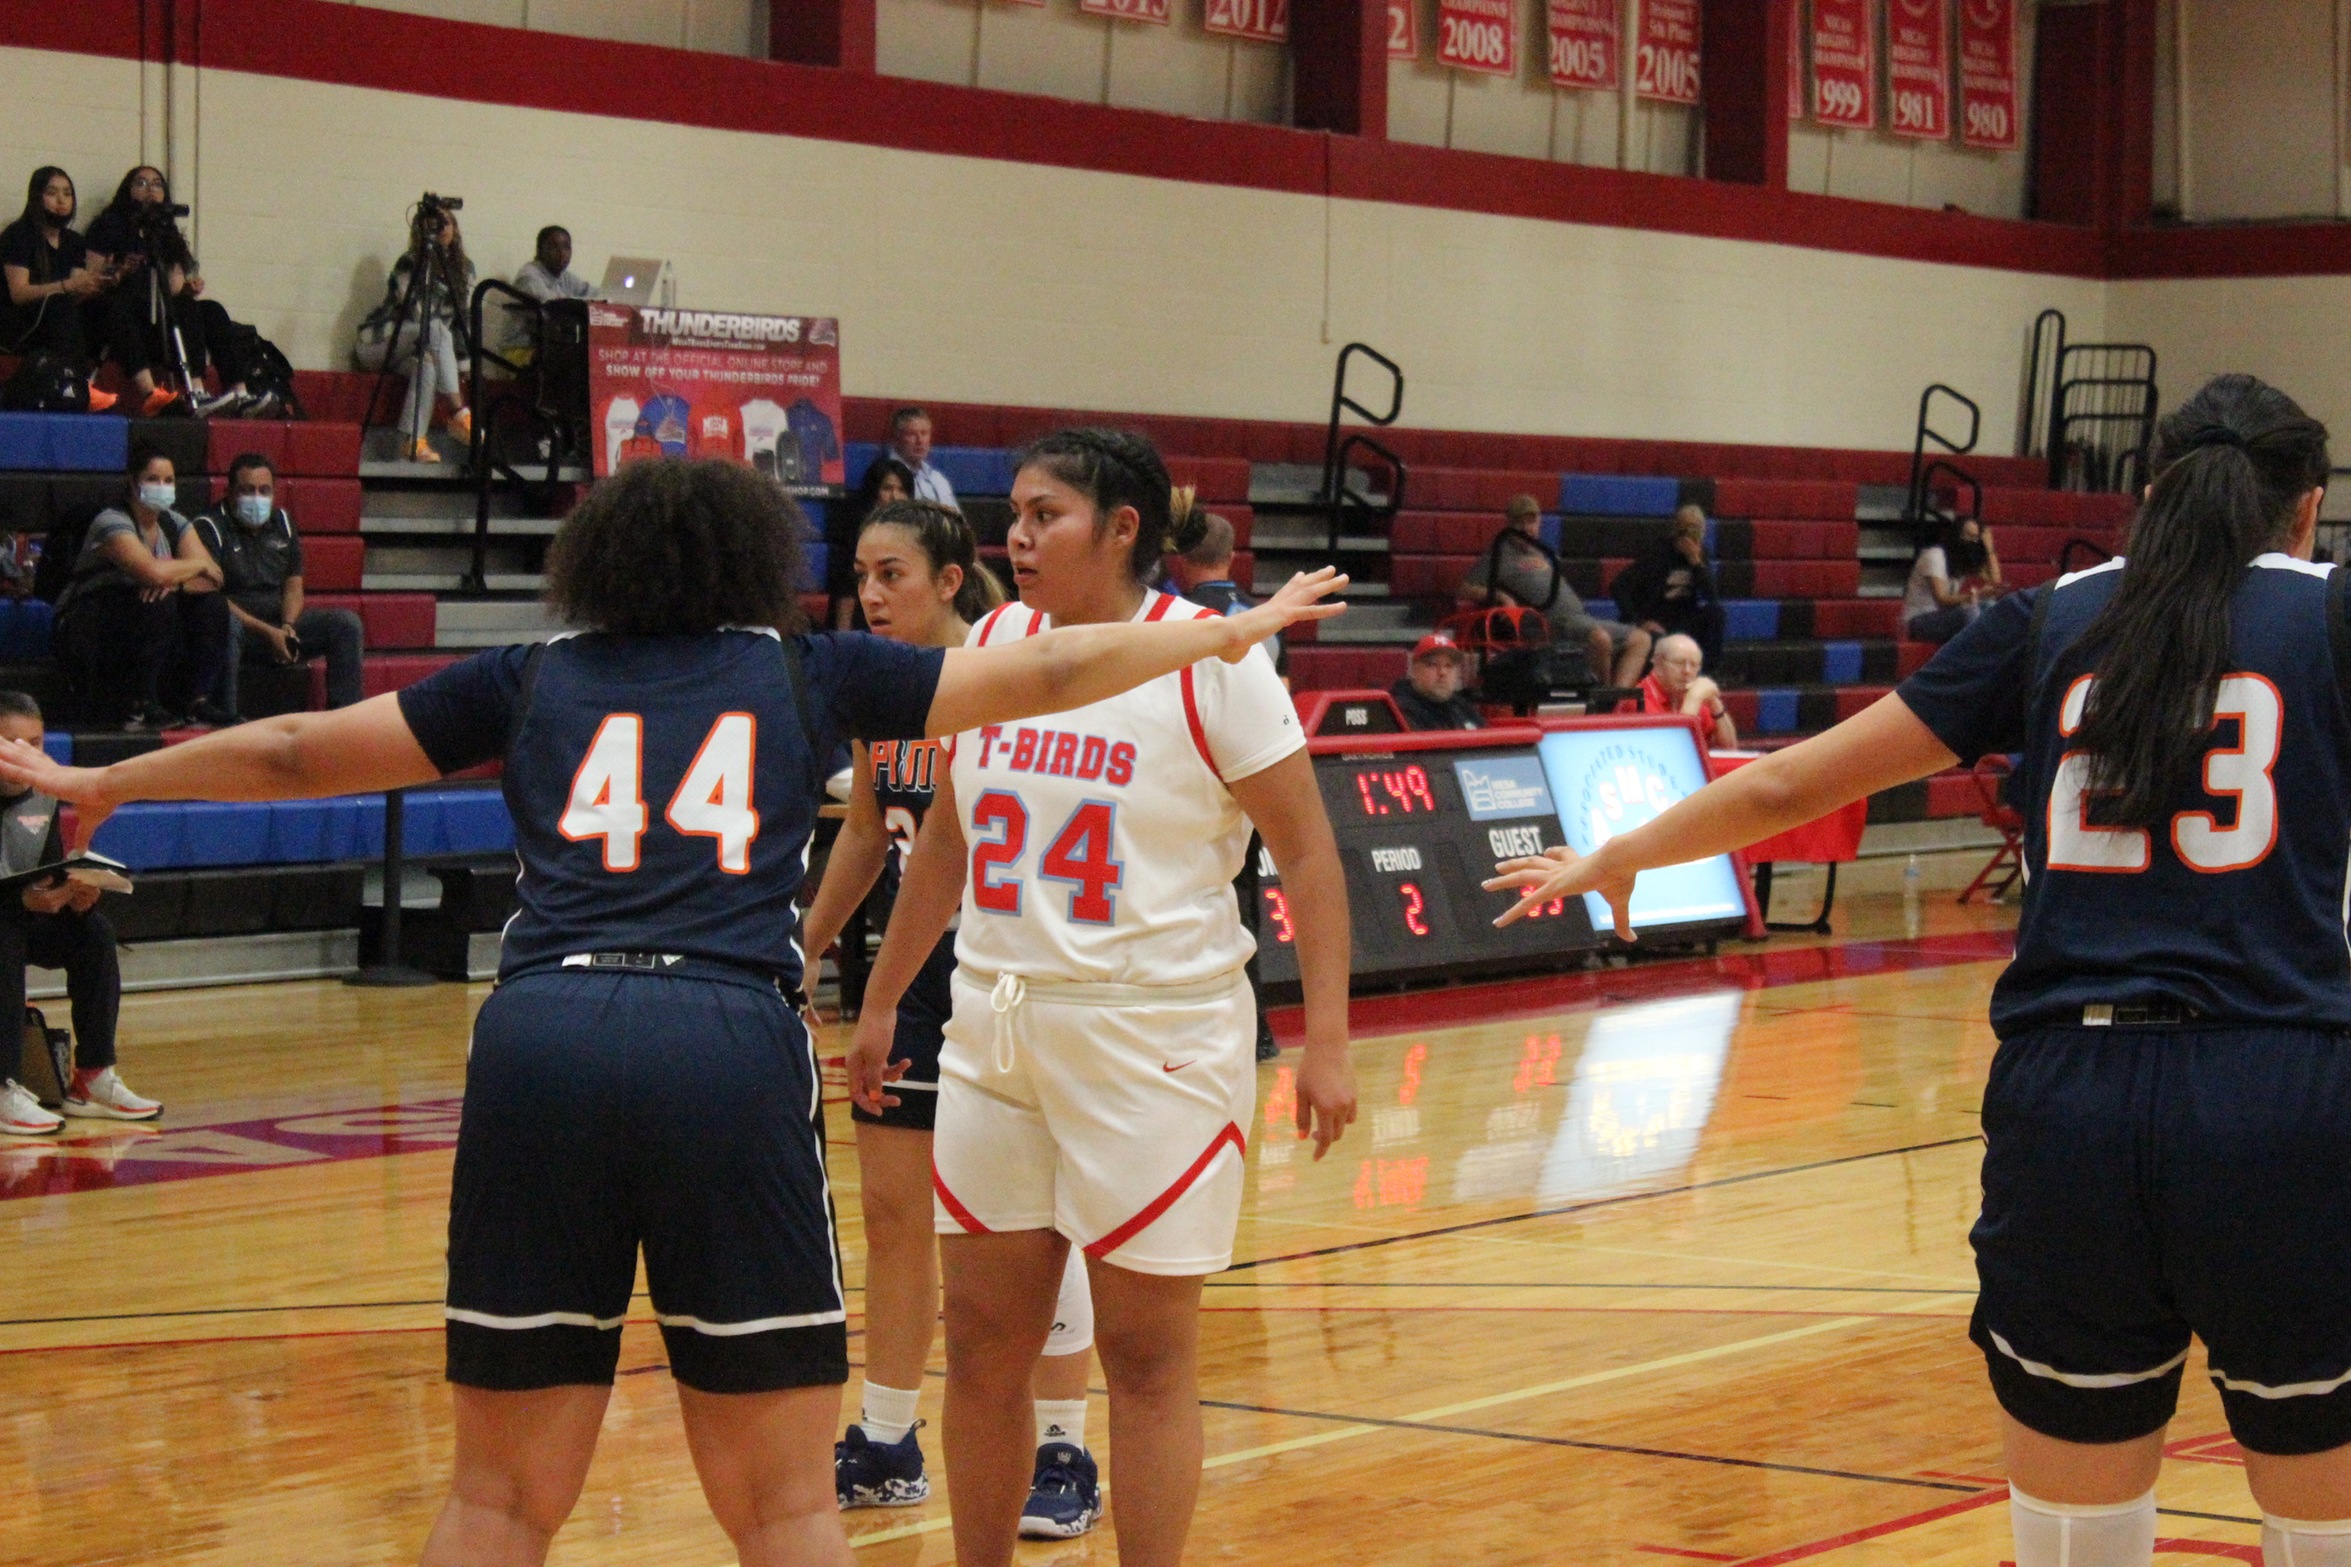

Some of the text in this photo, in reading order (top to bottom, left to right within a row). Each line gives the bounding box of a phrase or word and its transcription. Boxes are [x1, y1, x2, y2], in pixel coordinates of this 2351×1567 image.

[1443, 17, 1504, 65] 2008
[1967, 101, 2008, 140] 980
[640, 308, 801, 343] THUNDERBIRDS
[598, 349, 828, 374] SHOP AT THE OFFICIAL ONLINE STORE AND
[606, 364, 641, 378] SHOW
[644, 365, 666, 379] OFF
[668, 366, 700, 381] YOUR
[702, 368, 785, 385] THUNDERBIRDS
[1345, 708, 1368, 725] POSS
[977, 724, 1137, 788] T-BIRDS
[2046, 671, 2285, 874] 23
[557, 712, 760, 875] 44
[1357, 765, 1435, 815] 1:49
[971, 788, 1125, 927] 24
[1371, 847, 1423, 873] PERIOD
[1488, 826, 1544, 858] GUEST
[1400, 883, 1430, 936] 2
